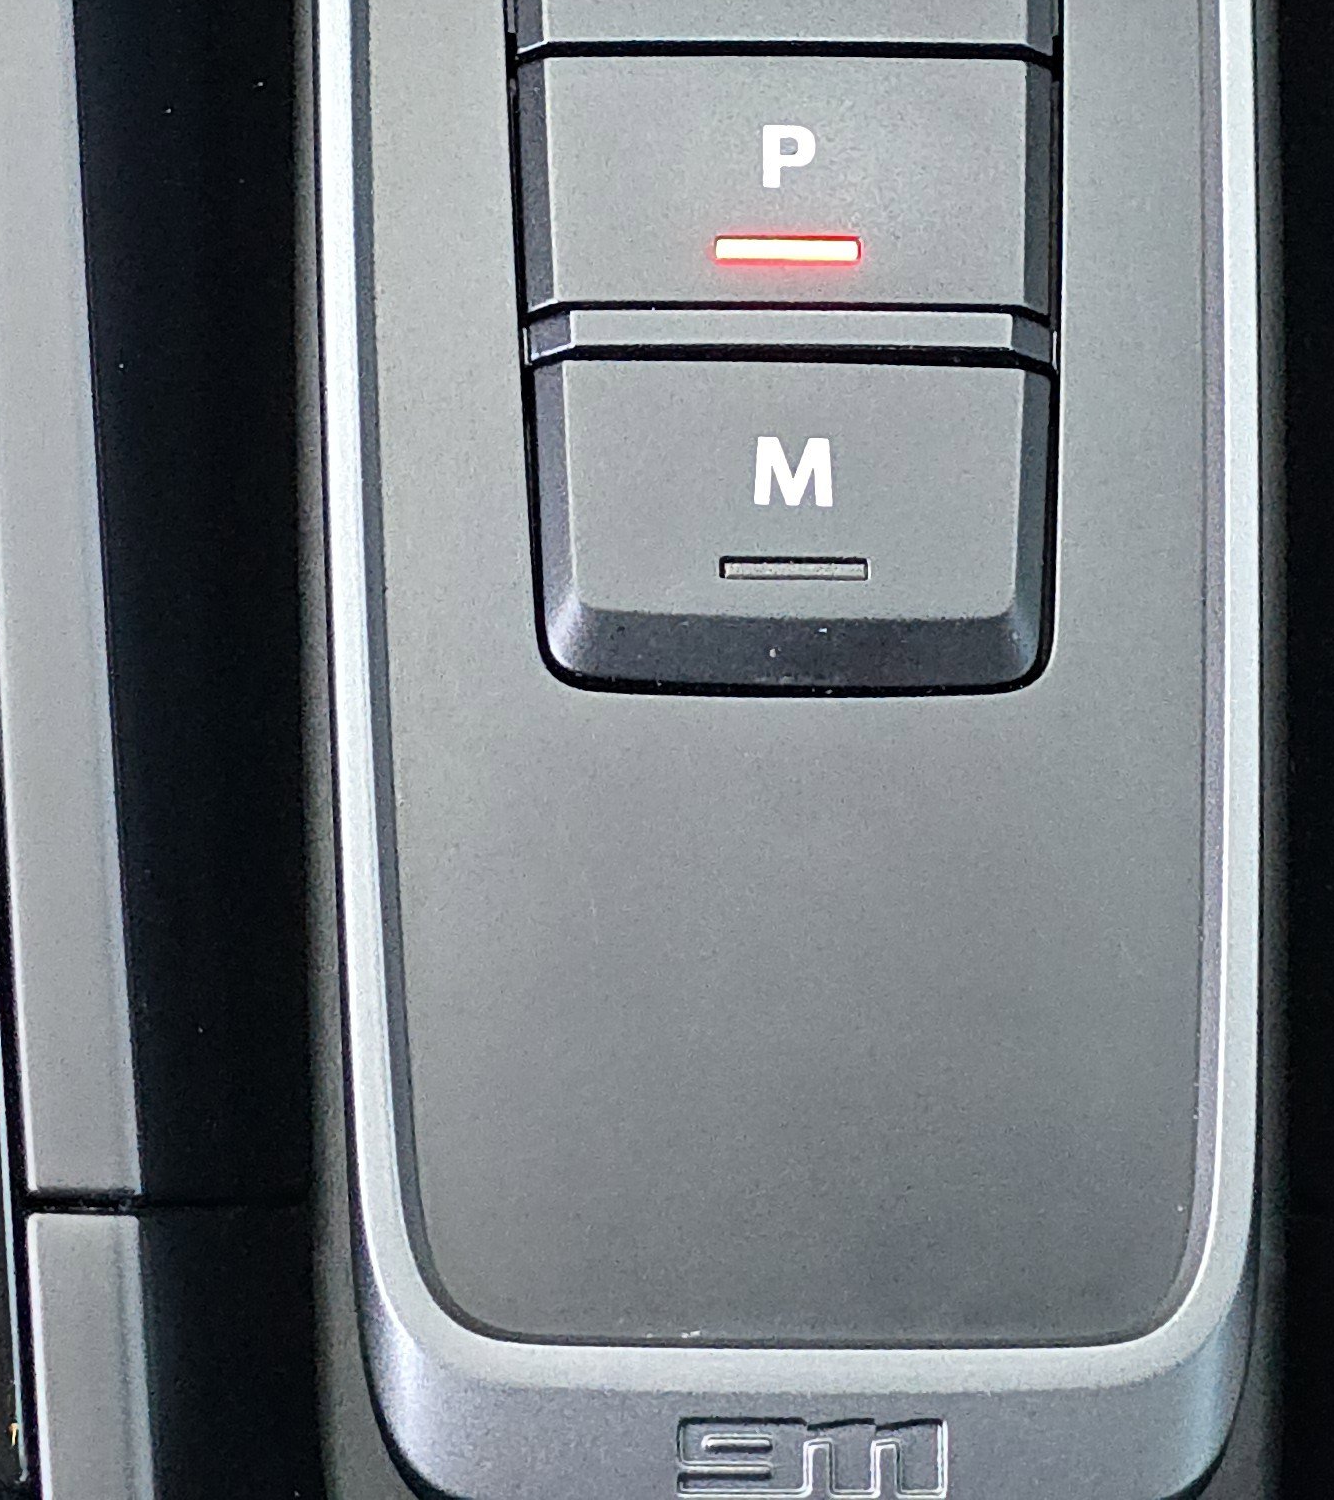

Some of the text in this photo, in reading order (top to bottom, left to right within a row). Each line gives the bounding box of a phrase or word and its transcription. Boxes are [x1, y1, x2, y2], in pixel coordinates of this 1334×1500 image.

[762, 124, 816, 189] P
[753, 436, 833, 507] M
[676, 1416, 948, 1499] 911
